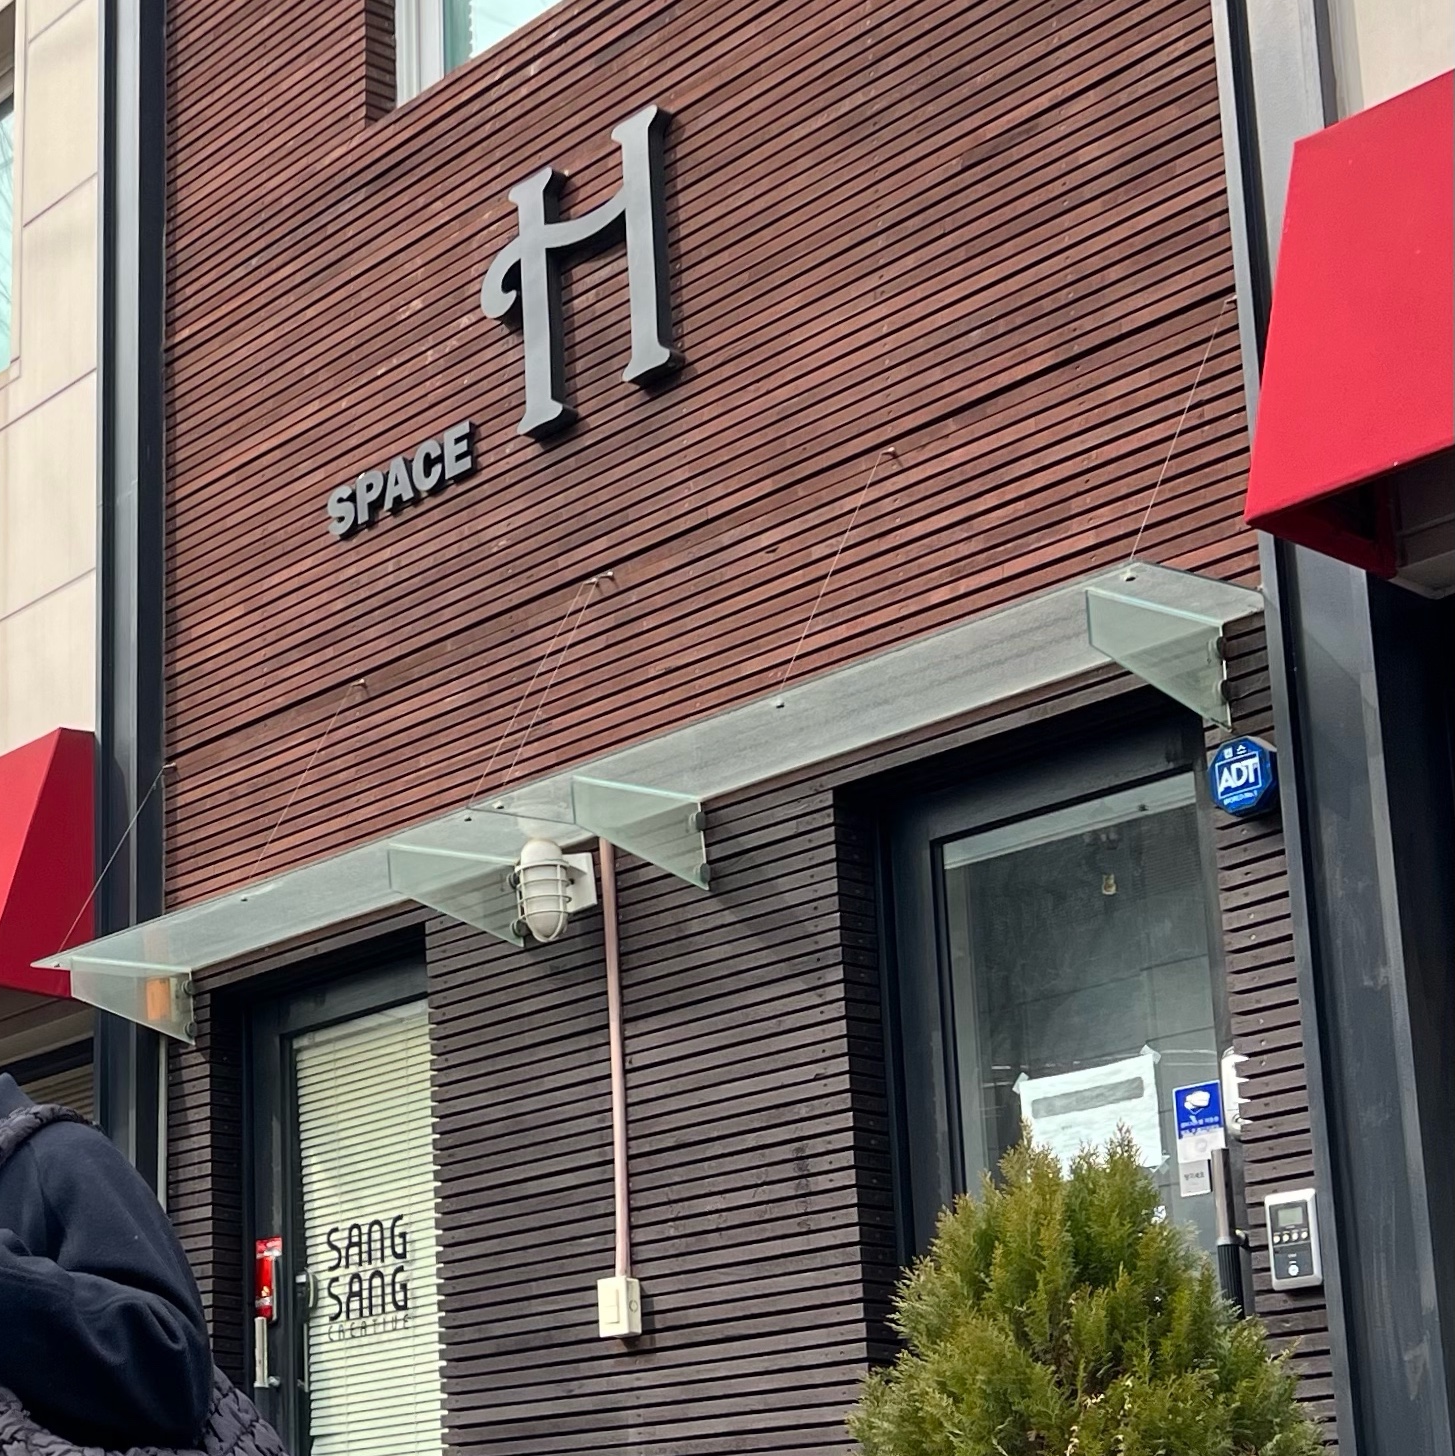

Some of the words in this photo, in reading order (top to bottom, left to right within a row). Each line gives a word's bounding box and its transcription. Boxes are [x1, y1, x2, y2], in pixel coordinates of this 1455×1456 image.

[327, 420, 473, 536] SPACE
[480, 104, 674, 437] H
[1218, 757, 1259, 792] ADT
[326, 1214, 407, 1272] SANG
[327, 1265, 408, 1321] SANG
